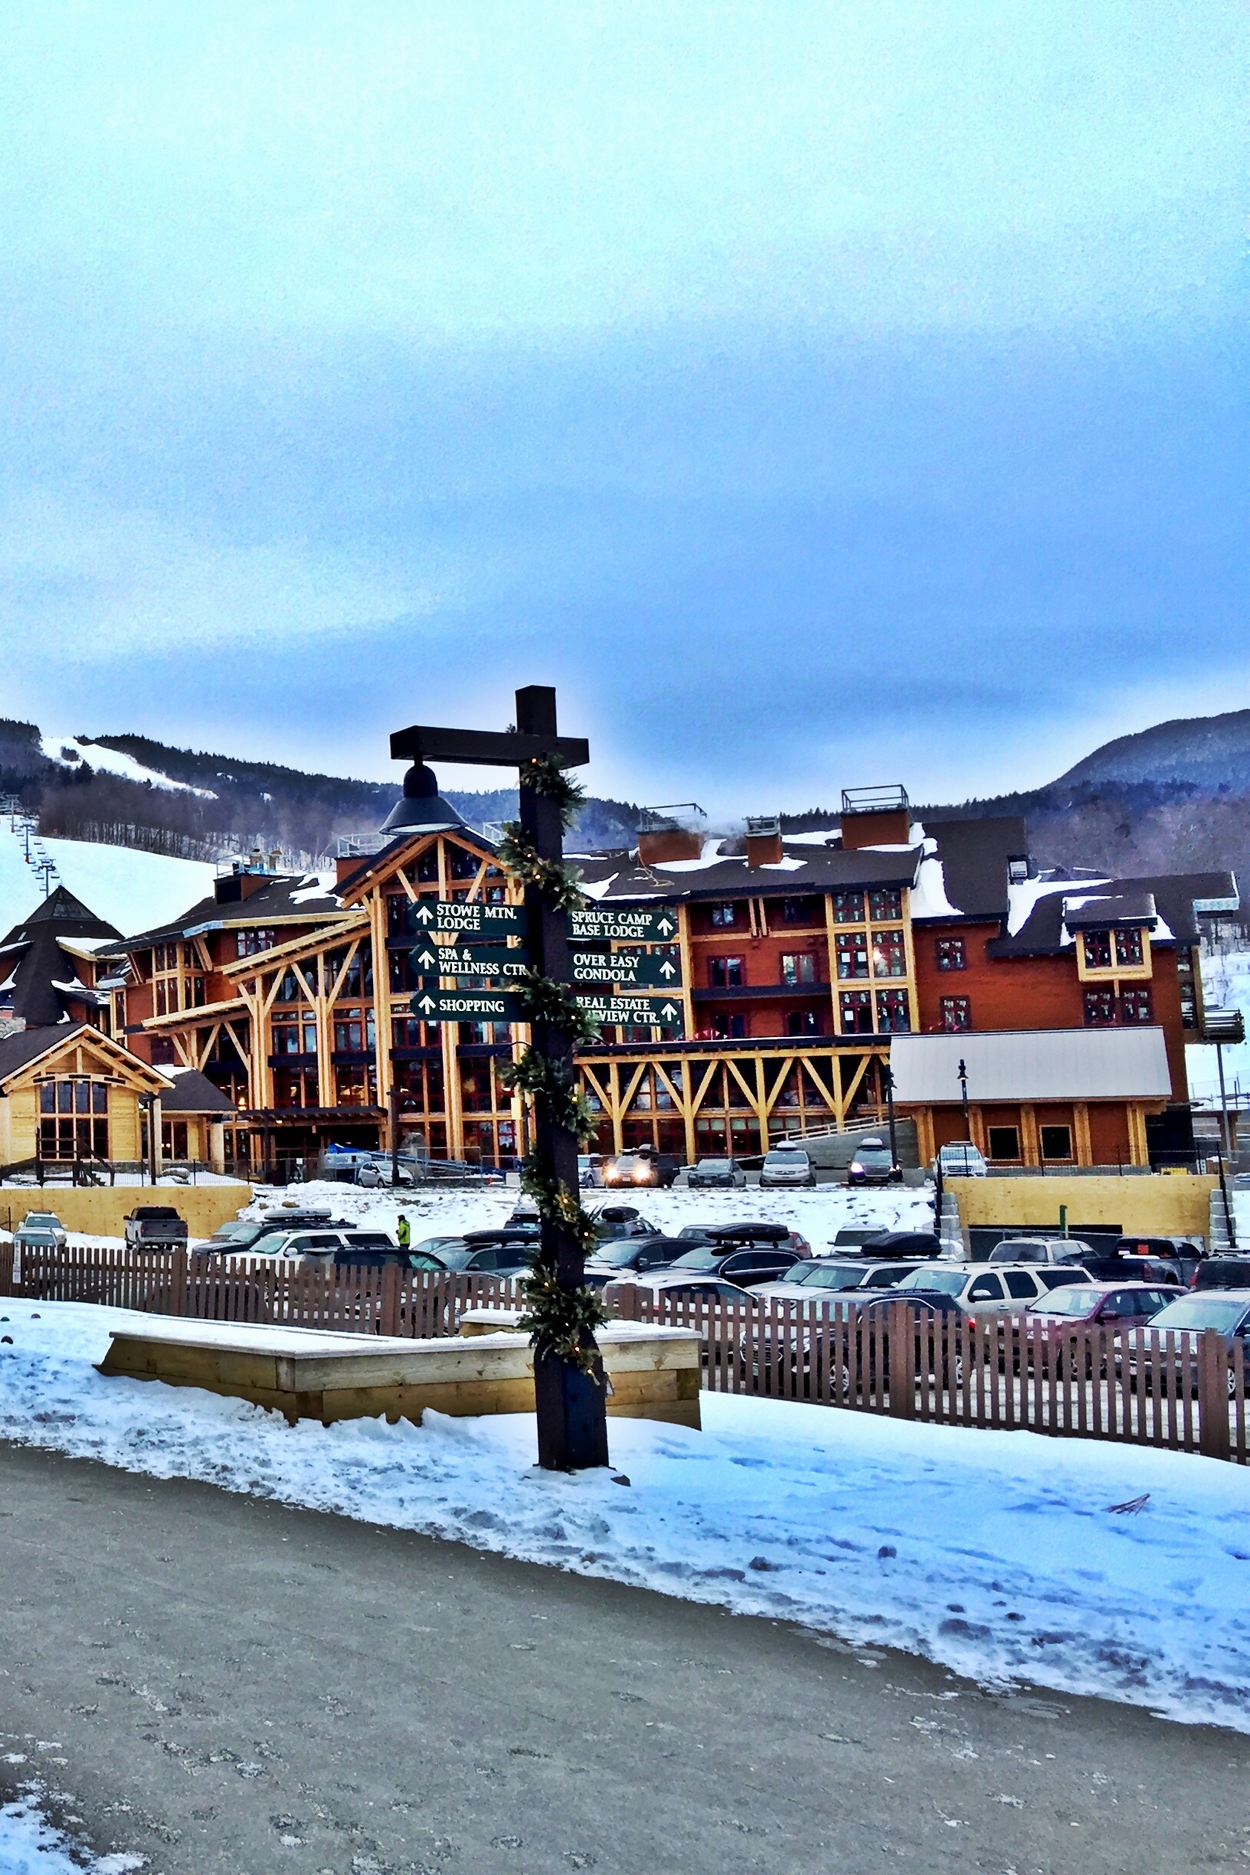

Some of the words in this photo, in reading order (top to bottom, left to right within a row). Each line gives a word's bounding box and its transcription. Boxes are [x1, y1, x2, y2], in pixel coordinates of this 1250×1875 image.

[436, 903, 481, 918] STOWE
[484, 906, 517, 919] MTN.
[437, 917, 481, 930] LODGE
[571, 911, 615, 924] SPRUCE
[617, 913, 653, 926] CAMP
[572, 924, 601, 936] BASE
[604, 925, 645, 937] LODGE
[438, 947, 458, 960] SPA
[462, 948, 472, 961] &
[573, 953, 607, 966] OVER
[610, 955, 640, 968] EASY
[439, 961, 500, 975] WELLNESS
[574, 967, 637, 981] GONDOLA
[439, 999, 505, 1013] SHOPPING
[576, 996, 607, 1009] REAL
[610, 997, 650, 1010] ESTATE
[633, 1011, 660, 1023] CTR.
